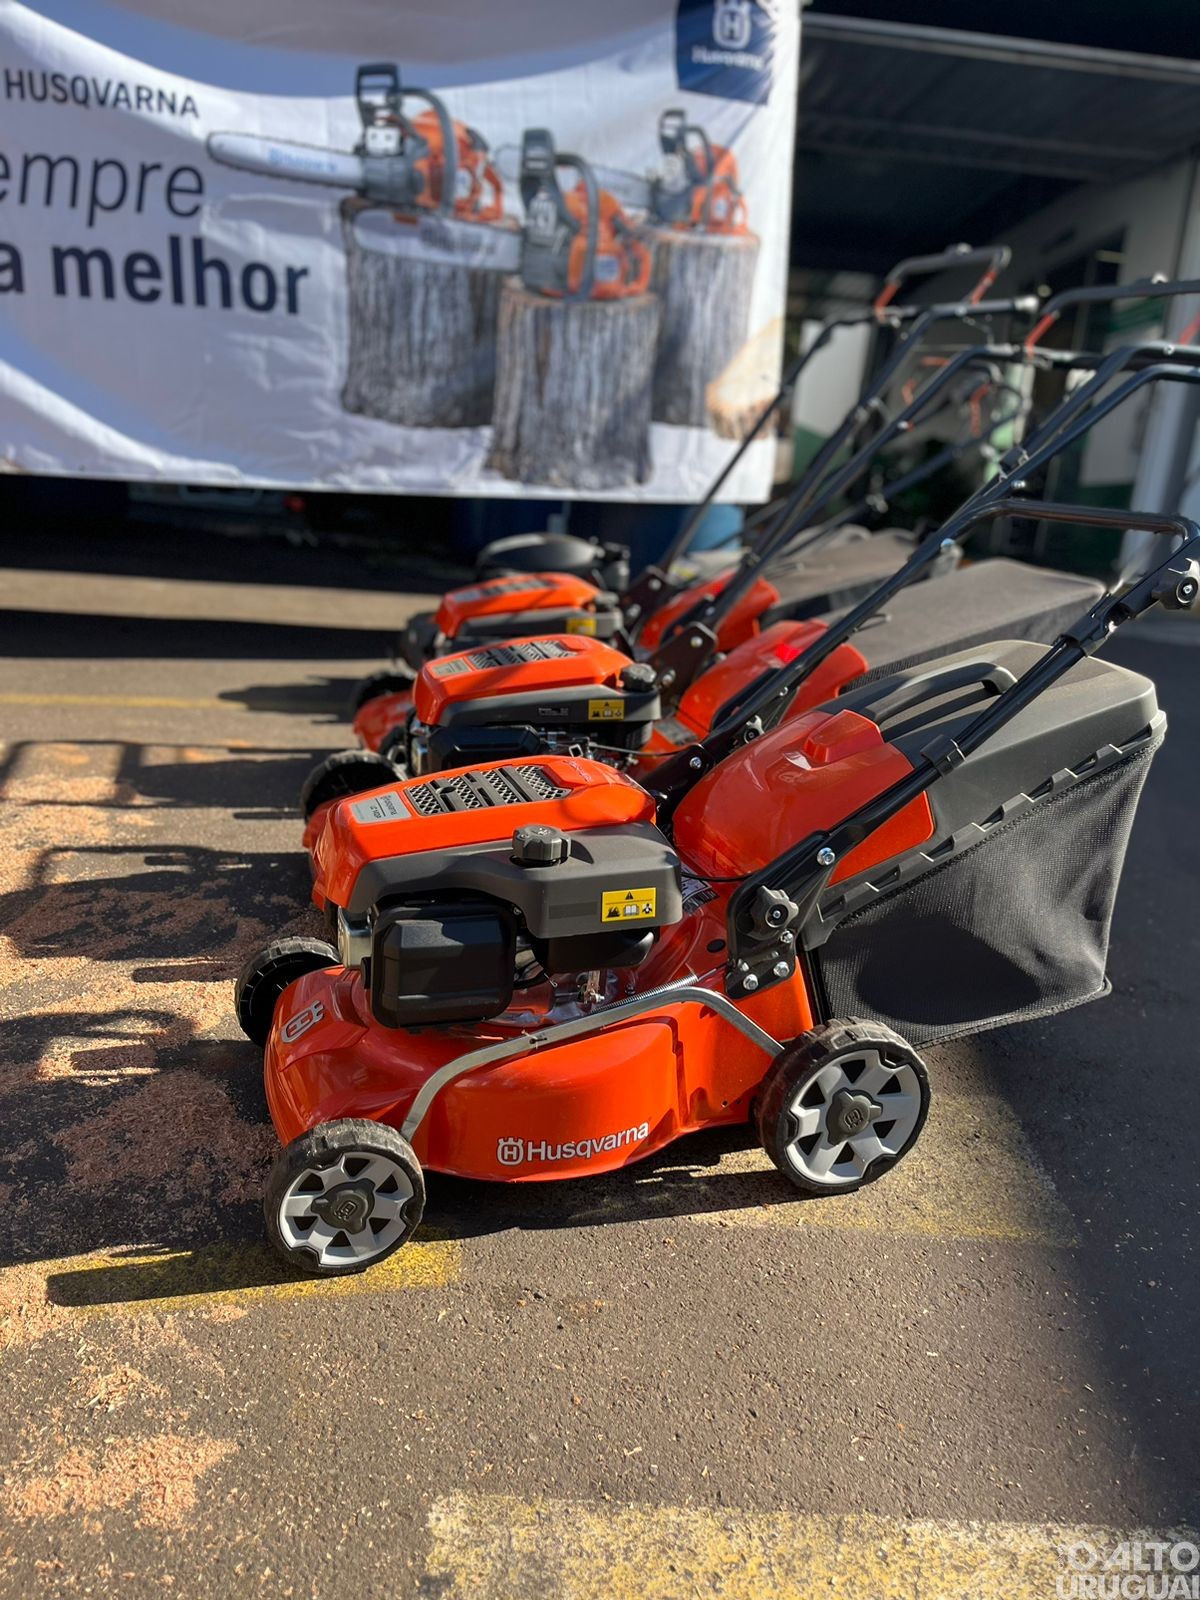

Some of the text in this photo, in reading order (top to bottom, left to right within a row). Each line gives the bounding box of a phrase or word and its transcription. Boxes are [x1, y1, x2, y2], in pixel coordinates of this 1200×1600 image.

[4, 68, 199, 119] HUSQVARNA
[0, 150, 205, 228] mpre
[50, 234, 309, 315] melhor
[527, 1121, 650, 1162] Husqvarna
